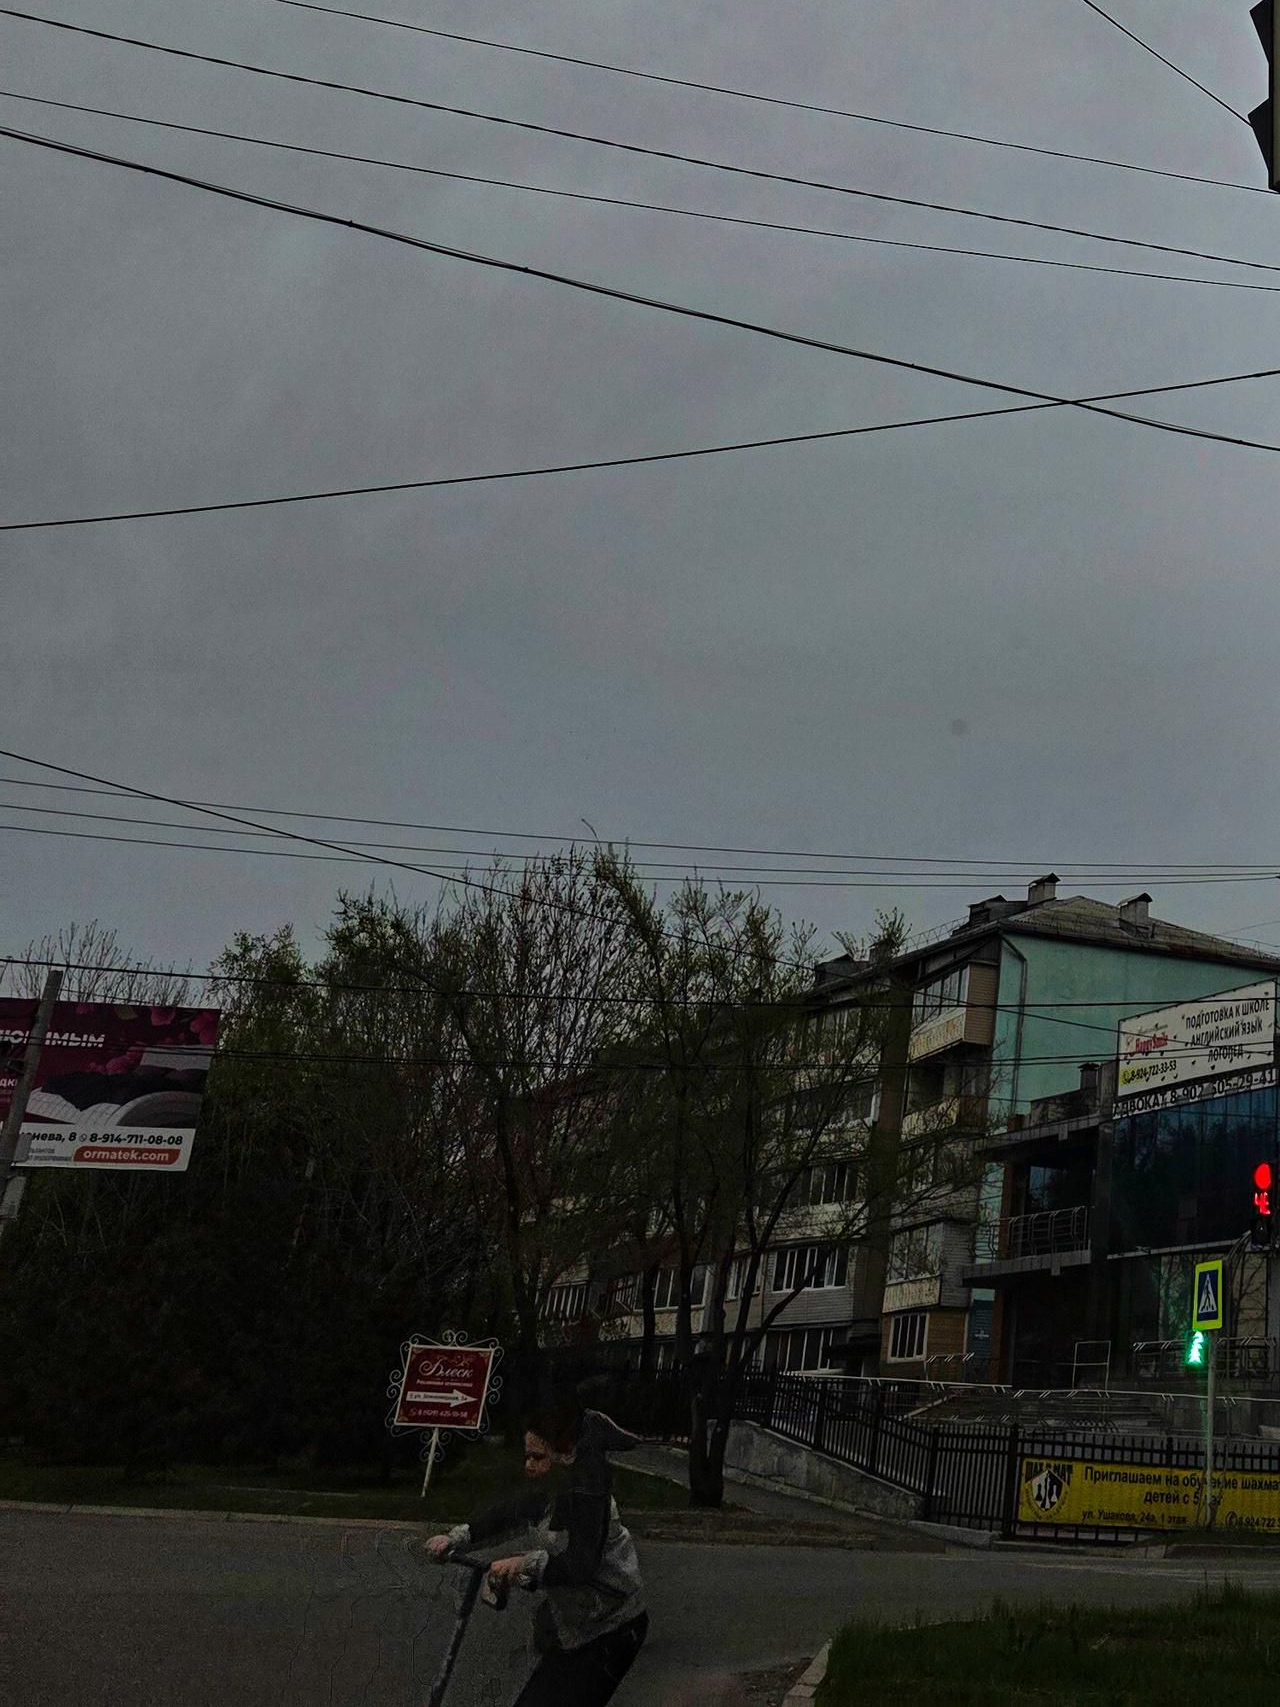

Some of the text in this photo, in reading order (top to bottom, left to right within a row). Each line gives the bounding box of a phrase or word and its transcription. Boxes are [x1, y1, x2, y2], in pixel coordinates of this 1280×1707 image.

[1186, 1006, 1234, 1029] ПОДГОТОВКА
[1235, 1006, 1240, 1017] К
[1241, 998, 1270, 1016] ШКОЛЕ
[1190, 1022, 1240, 1047] АНГЛИЙСКИЙ
[1241, 1019, 1263, 1035] ЯЗЫК
[89, 1132, 183, 1145] 8-914-711-08-08
[83, 1150, 170, 1162] ormatek.com
[418, 1356, 474, 1379] Блеск
[1085, 1466, 1161, 1485] Приглашаем
[1165, 1475, 1179, 1487] на
[1143, 1490, 1180, 1505] детей
[1246, 1517, 1260, 1527] 924
[1261, 1518, 1275, 1527] 722
